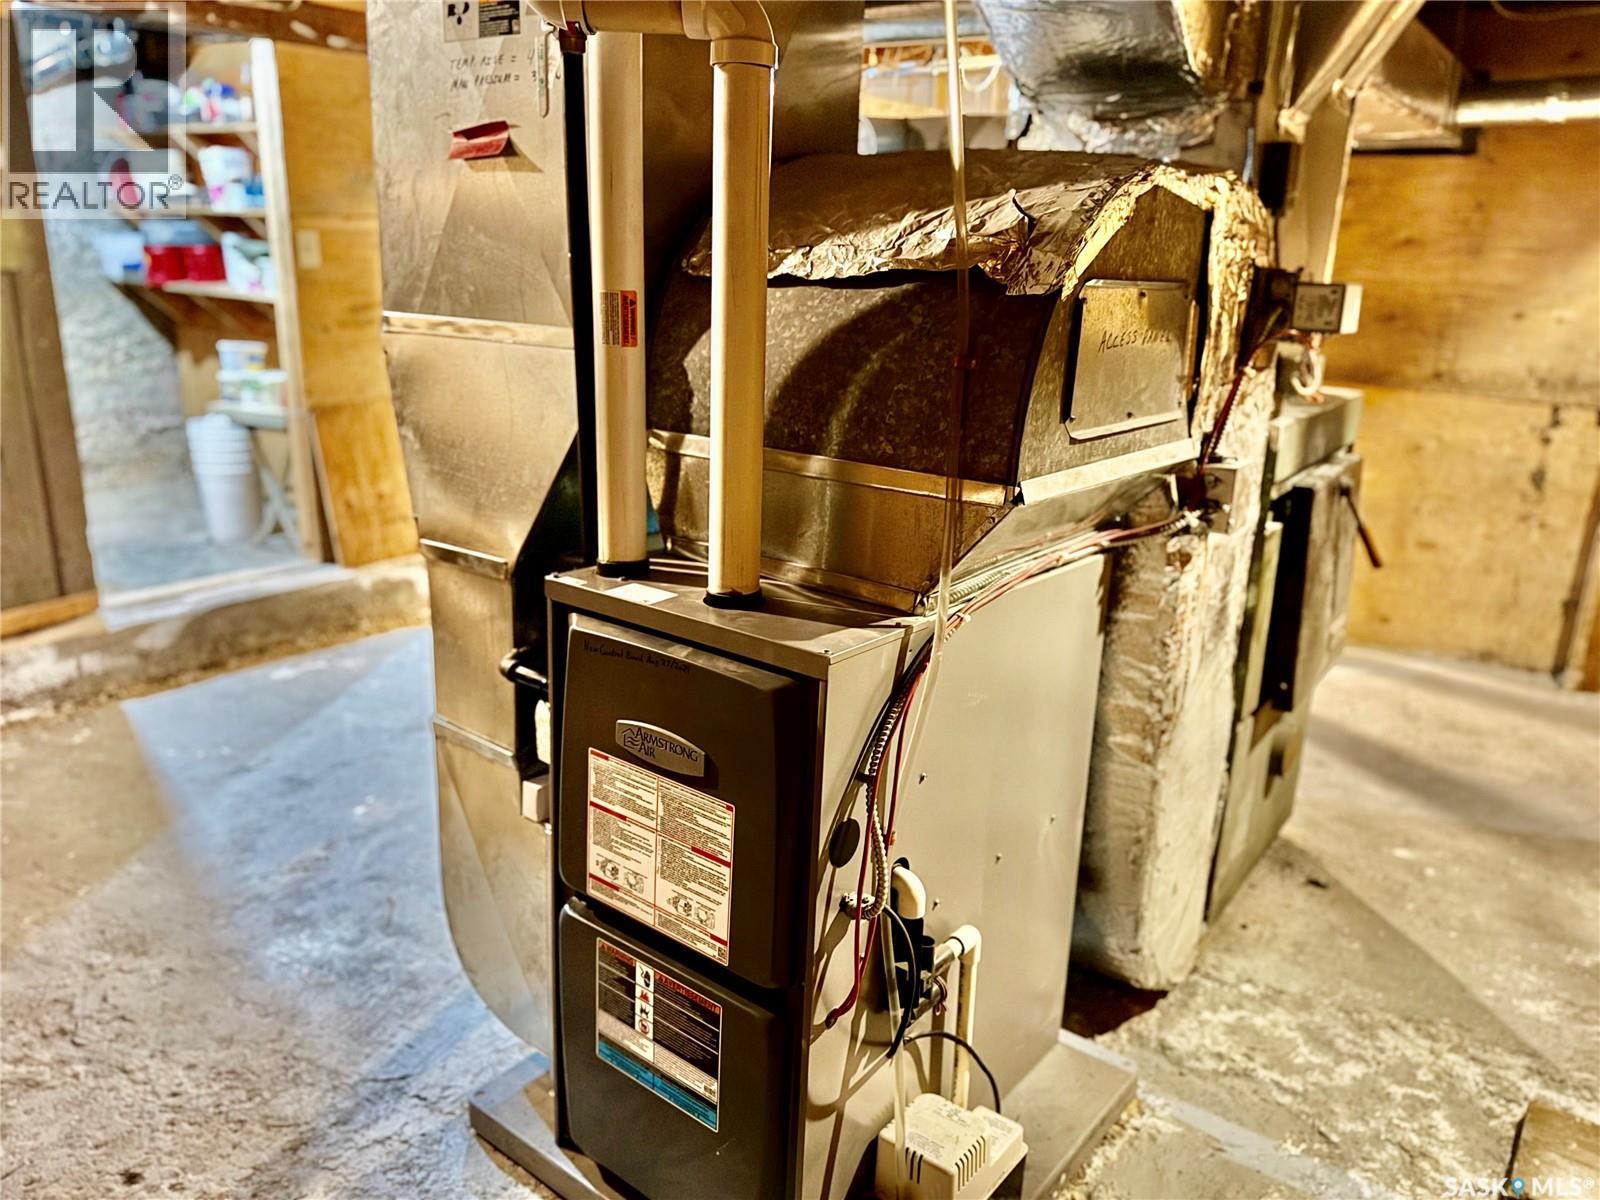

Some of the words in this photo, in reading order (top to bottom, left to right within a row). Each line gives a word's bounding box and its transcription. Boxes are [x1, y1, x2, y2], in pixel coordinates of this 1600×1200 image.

[1098, 329, 1138, 353] ACCESS
[635, 727, 699, 762] ARMSTRONG
[638, 741, 656, 759] AIR
